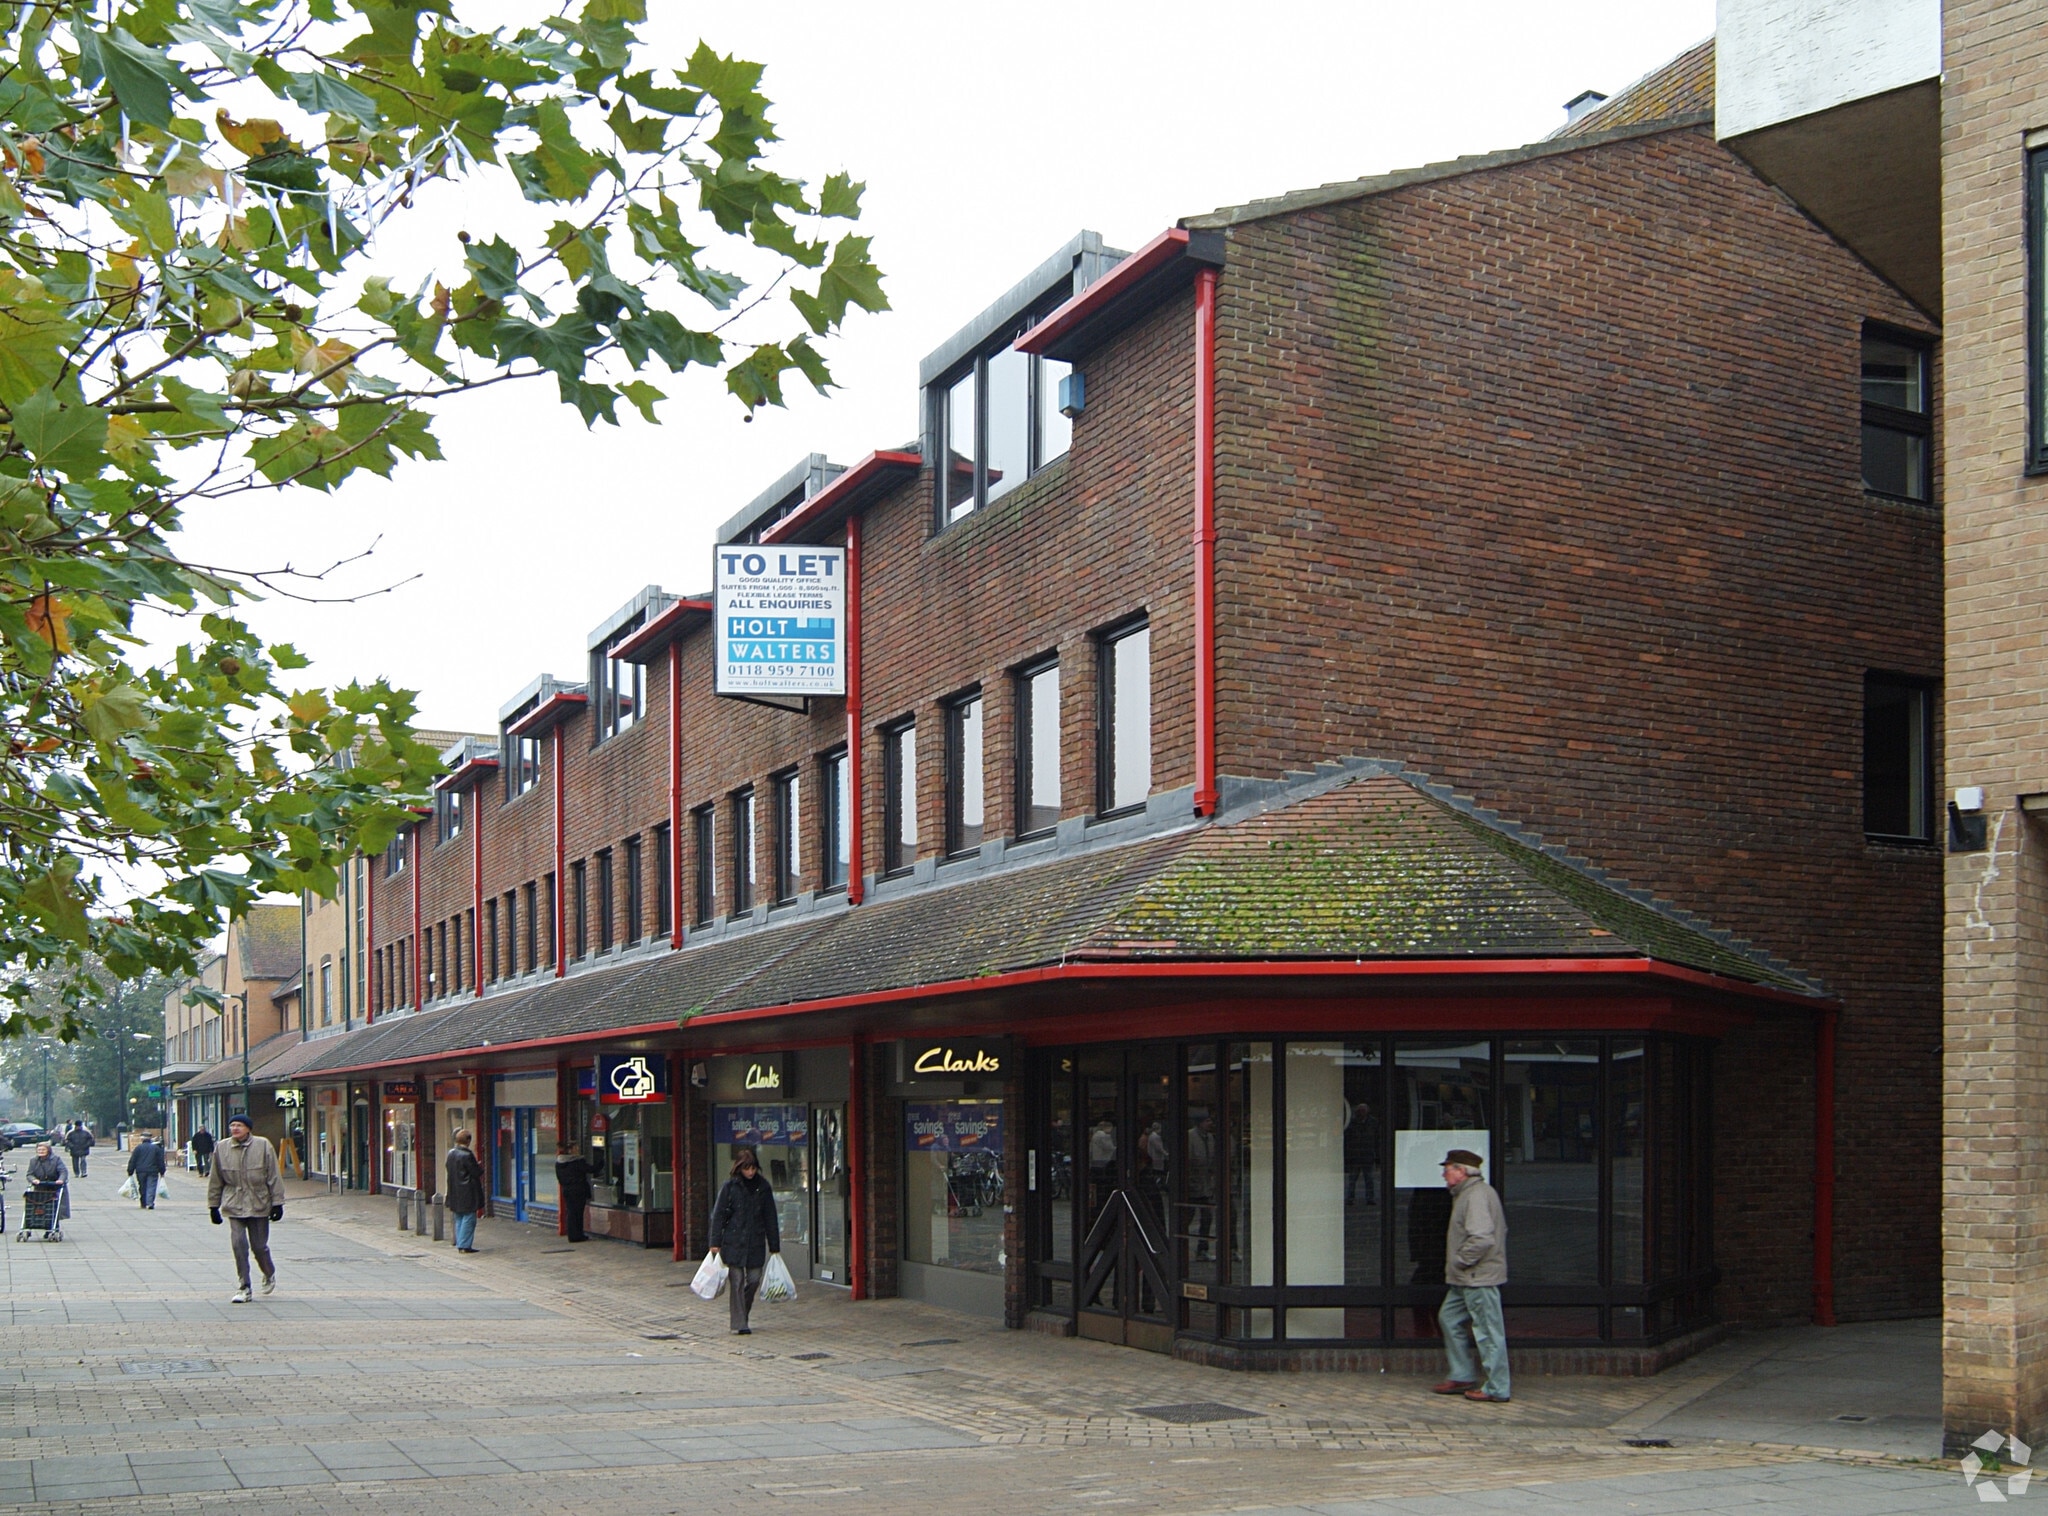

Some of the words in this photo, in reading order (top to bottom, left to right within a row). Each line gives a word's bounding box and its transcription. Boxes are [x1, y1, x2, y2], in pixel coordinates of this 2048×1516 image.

[721, 553, 766, 576] TO
[779, 554, 840, 576] LET
[729, 600, 754, 609] ALL
[759, 600, 833, 609] ENQUIRIES
[733, 619, 788, 635] HOLT
[732, 643, 830, 660] WALTERS
[728, 664, 762, 676] 0118
[768, 664, 794, 676] 959
[799, 665, 834, 677] 7100
[728, 679, 834, 687] www.holtwalters.co.uk
[914, 1047, 1000, 1073] Clarks
[745, 1063, 780, 1090] Clarks
[913, 1118, 945, 1138] savings
[955, 1117, 988, 1138] savings
